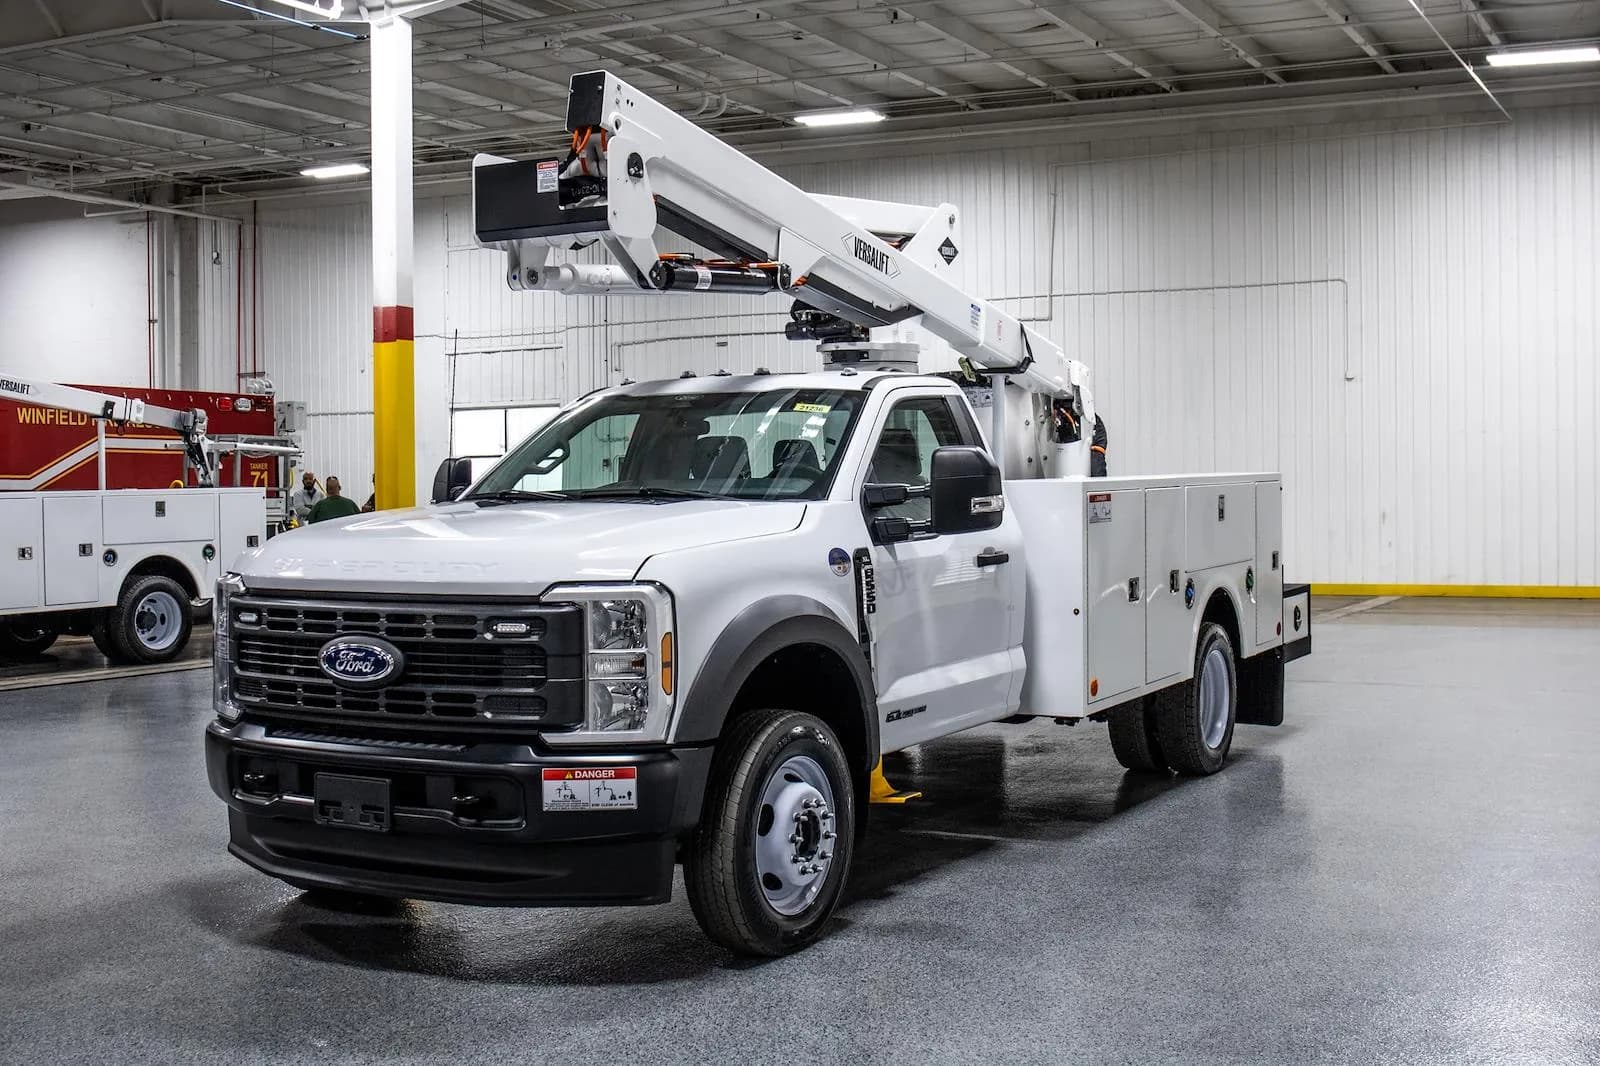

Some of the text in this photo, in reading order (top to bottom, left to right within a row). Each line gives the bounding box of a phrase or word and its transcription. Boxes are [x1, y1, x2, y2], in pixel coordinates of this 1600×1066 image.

[854, 236, 889, 275] VERSALIFT
[16, 407, 88, 427] WINFIELD
[250, 470, 269, 487] 71
[335, 649, 376, 673] Ford
[574, 770, 615, 779] DANGER
